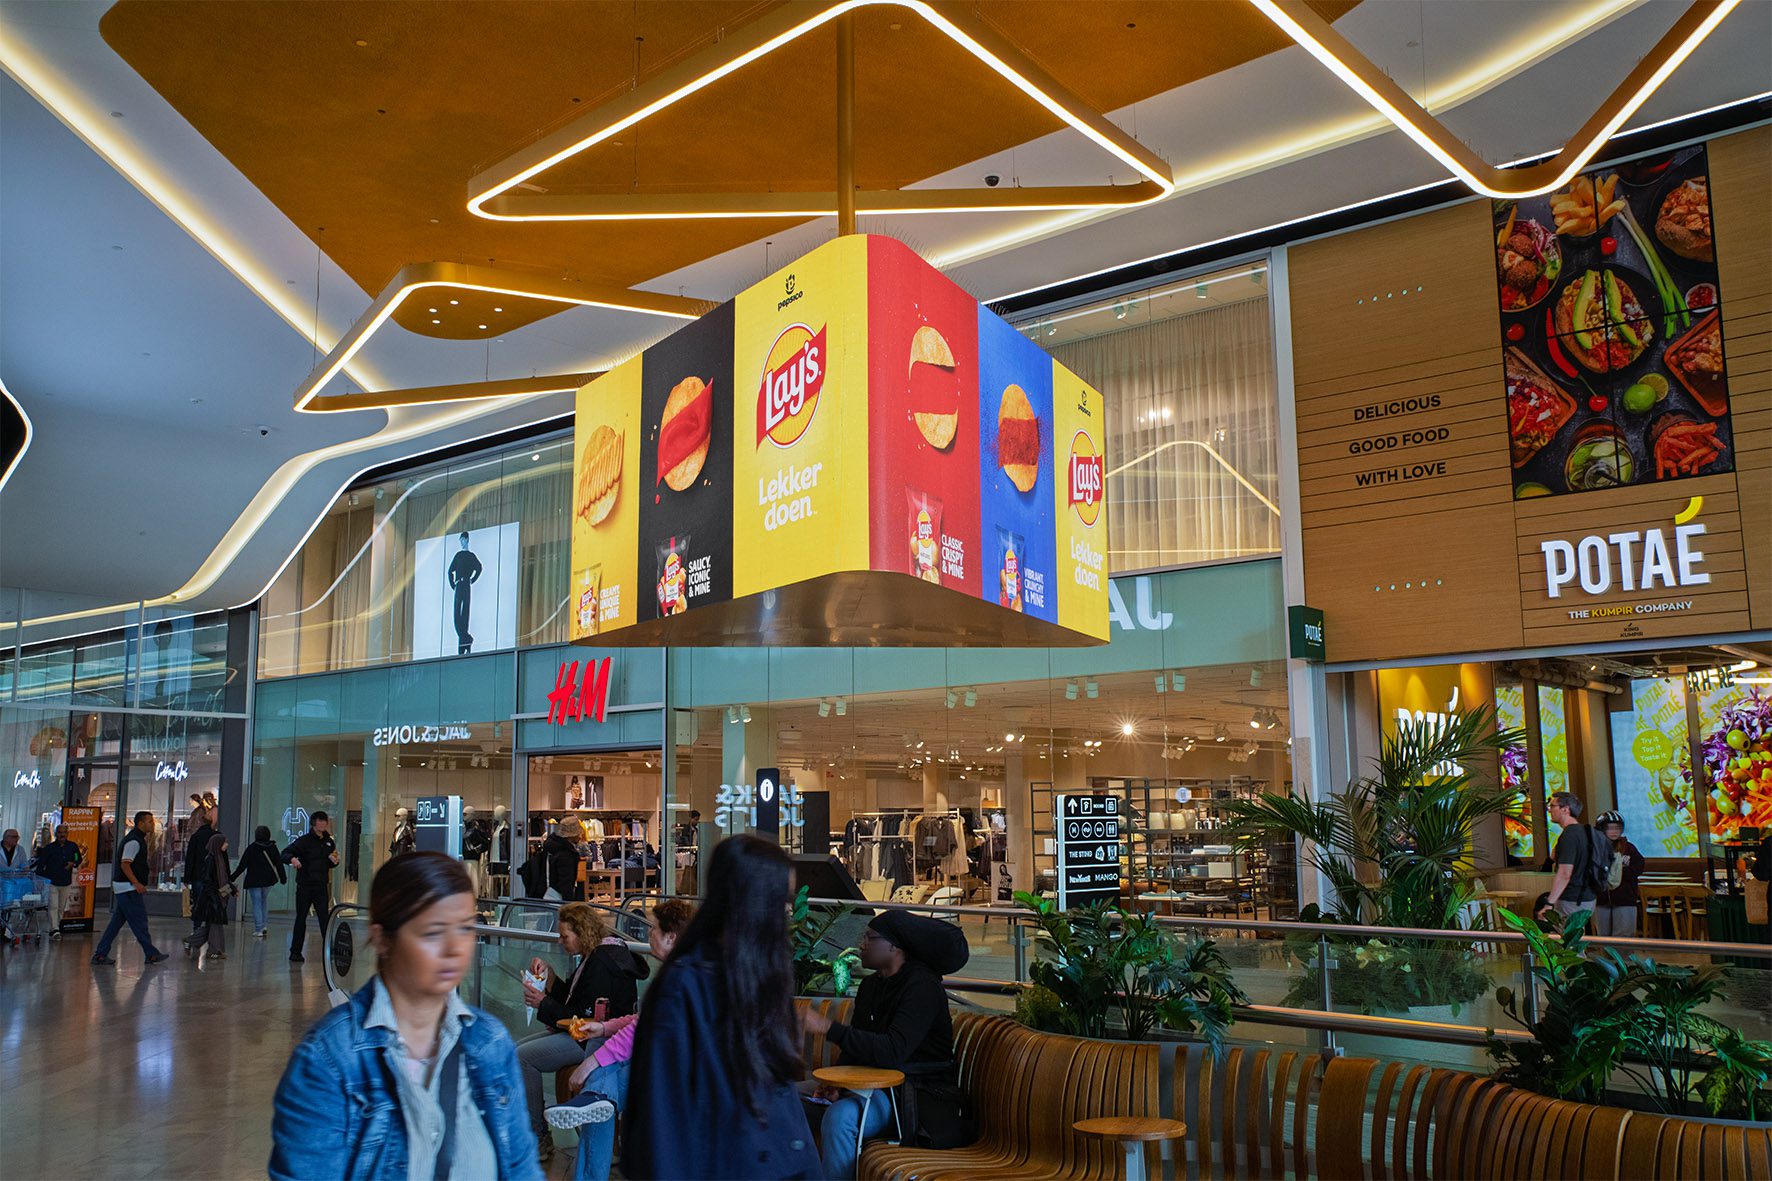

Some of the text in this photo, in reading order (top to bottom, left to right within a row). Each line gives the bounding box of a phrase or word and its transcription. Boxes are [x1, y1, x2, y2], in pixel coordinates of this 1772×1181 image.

[777, 290, 804, 312] pepsico
[765, 341, 821, 433] Lay's
[1354, 395, 1441, 420] DELICIOUS
[1349, 428, 1450, 454] GOOD FOOD
[759, 462, 823, 506] Lekker
[1355, 462, 1447, 487] WITH LOVE
[1070, 535, 1103, 571] Lekker
[1540, 495, 1711, 598] POTAÉ
[688, 569, 711, 586] ICONIC
[948, 562, 964, 580] MINE
[688, 586, 694, 598] &
[694, 581, 711, 596] MINE
[1568, 601, 1693, 619] THE KUMPIR COMPANY
[547, 656, 613, 727] H&M
[1095, 873, 1118, 881] MANGO
